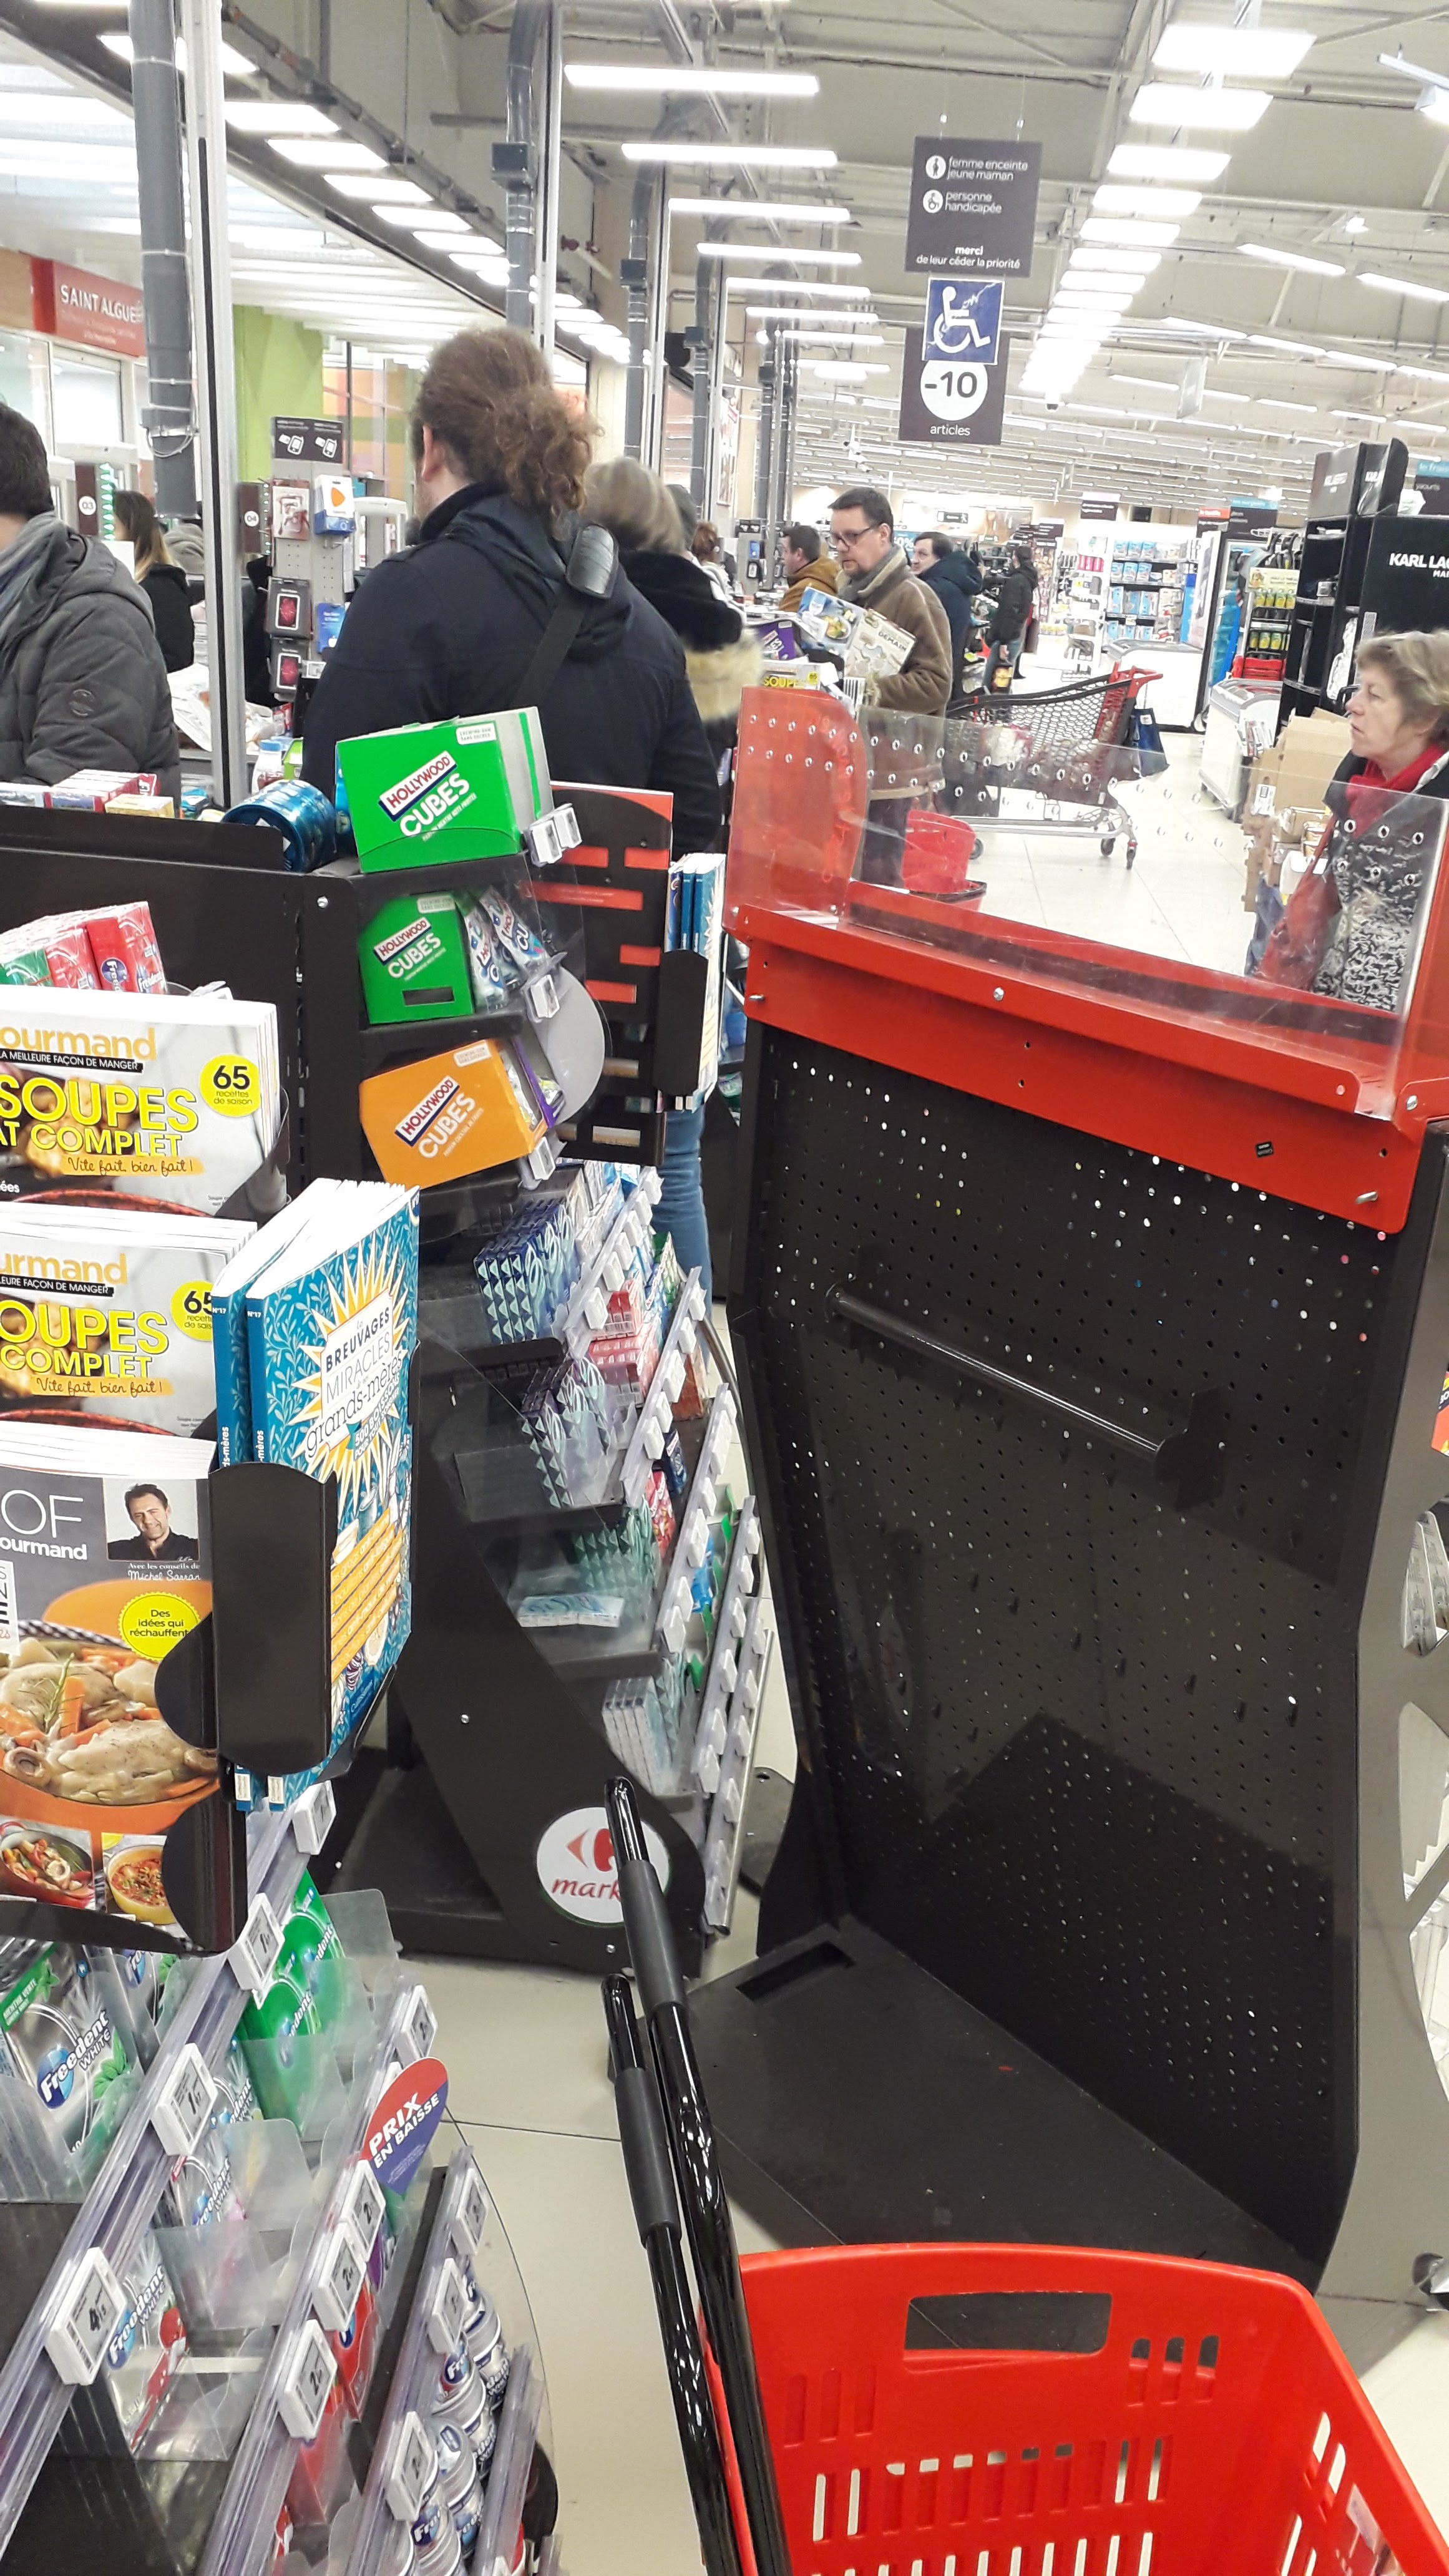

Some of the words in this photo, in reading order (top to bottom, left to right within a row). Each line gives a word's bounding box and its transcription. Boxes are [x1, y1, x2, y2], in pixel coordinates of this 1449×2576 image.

[947, 169, 975, 180] jeune
[977, 171, 1014, 181] maman
[948, 156, 983, 168] femme
[985, 160, 1028, 171] enceinte
[945, 192, 992, 203] personne
[945, 202, 1002, 215] handicapée
[917, 255, 928, 264] de
[930, 255, 947, 265] leur
[949, 256, 975, 266] céder
[977, 258, 985, 266] la
[987, 259, 1020, 269] priorité
[955, 245, 983, 255] merci
[59, 283, 99, 311] SAINT
[924, 371, 977, 398] -10
[930, 424, 970, 436] articles
[1389, 553, 1427, 568] KARL
[386, 755, 451, 809] HOLLYWOOD
[400, 773, 470, 837] CUBES
[378, 919, 427, 957] HOLLYWOOD
[388, 932, 442, 979] CUBES
[9, 1051, 51, 1064] MEILLEURE
[53, 1054, 84, 1068] FAÇON
[86, 1057, 97, 1067] DE
[99, 1058, 138, 1071] MANGER
[213, 1065, 250, 1090] 65
[216, 1090, 249, 1099] recettes
[401, 1078, 454, 1136] HOLLYWOOD
[418, 1093, 476, 1159] CUBES
[30, 1124, 183, 1158] COMPLET
[67, 1156, 95, 1173] Vite
[130, 1157, 159, 1173] bien
[23, 1279, 54, 1291] FAÇON
[56, 1282, 67, 1291] DE
[69, 1283, 109, 1294] MANGER
[326, 1307, 390, 1373] BREUVAGES
[1, 1345, 153, 1379] COMPLET
[326, 1331, 390, 1404] MIRACLES
[37, 1377, 64, 1392] Vite
[99, 1378, 127, 1392] bien
[306, 1350, 403, 1459] grands-mères
[355, 1427, 369, 1447] 500
[1, 1490, 84, 1539] OF
[127, 1569, 163, 1582] Michel
[137, 1618, 165, 1628] idées
[167, 1619, 184, 1629] qui
[150, 1609, 170, 1619] Des
[129, 1628, 190, 1639] réchauffent
[40, 2010, 109, 2102] Freedent
[79, 2028, 111, 2072] WHITE
[369, 2092, 422, 2158] PRIX
[374, 2142, 394, 2170] EN
[394, 2092, 440, 2147] BAISSE
